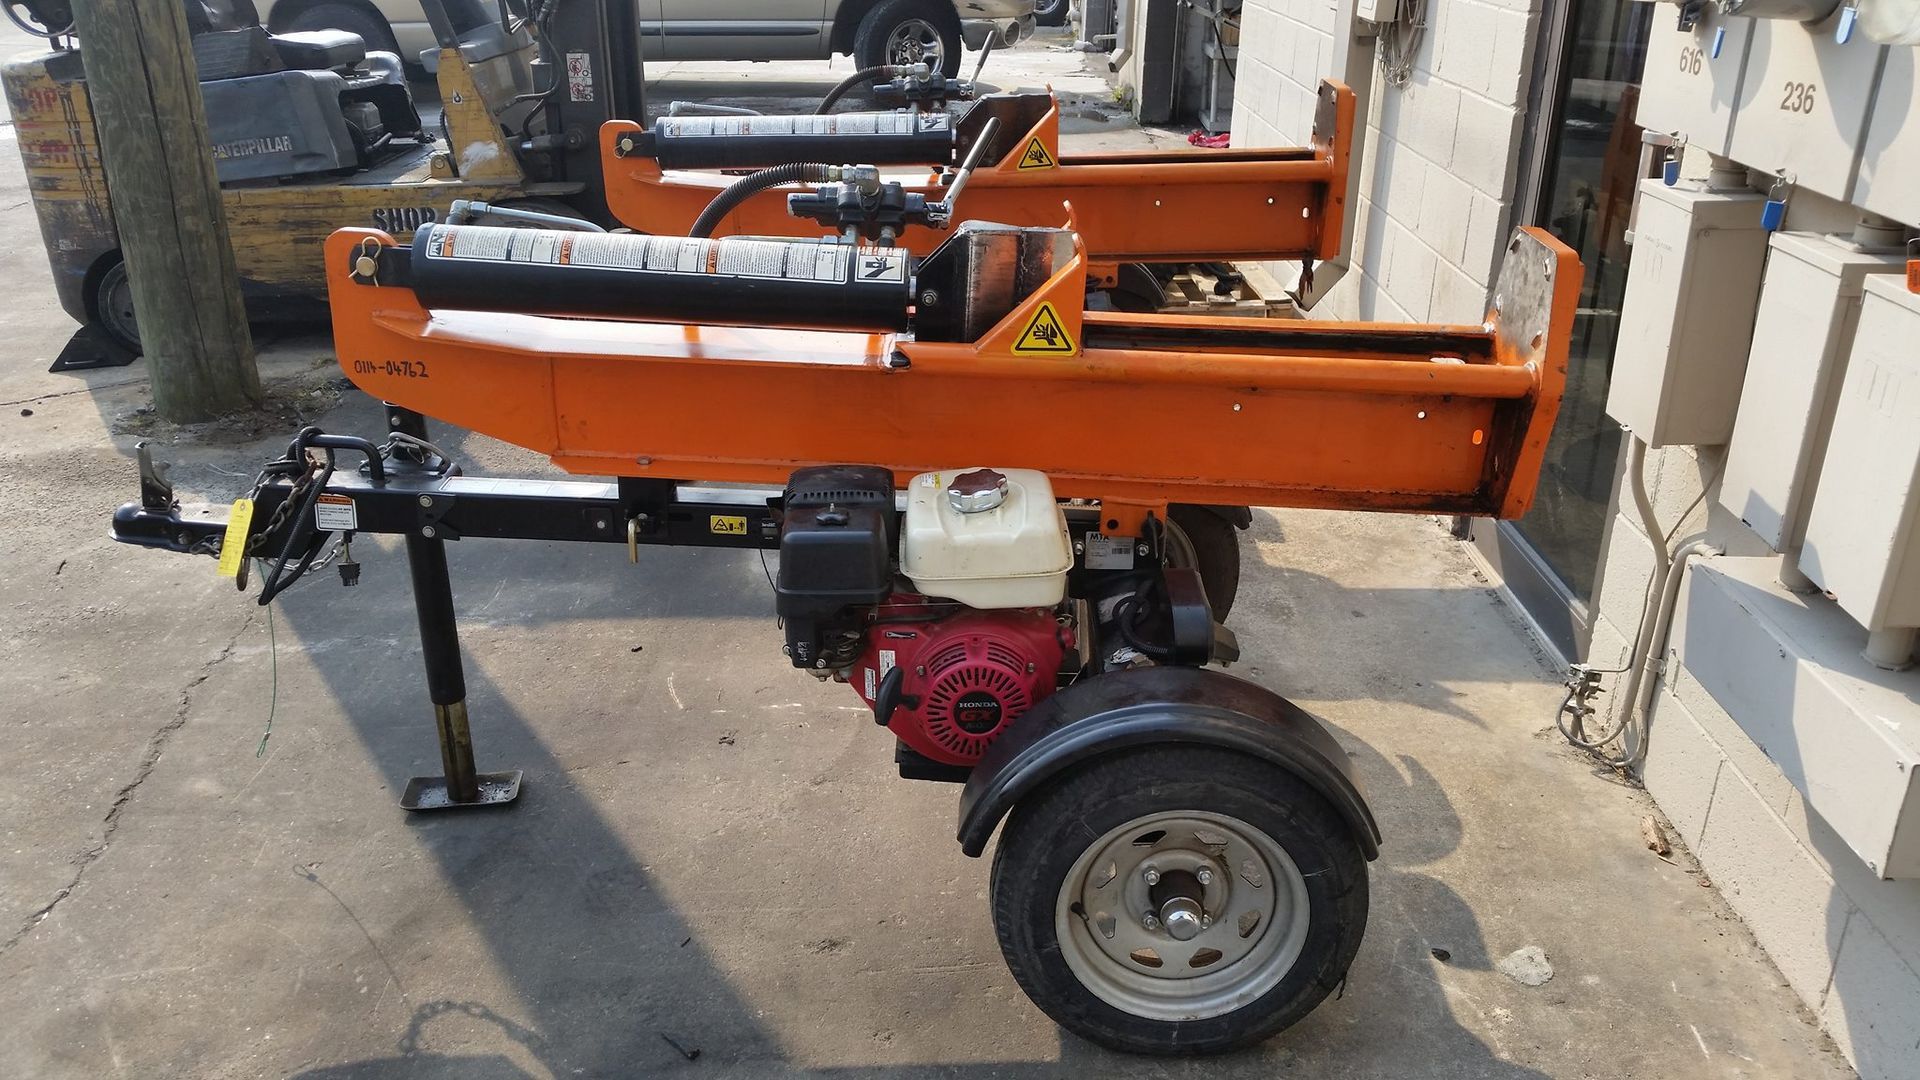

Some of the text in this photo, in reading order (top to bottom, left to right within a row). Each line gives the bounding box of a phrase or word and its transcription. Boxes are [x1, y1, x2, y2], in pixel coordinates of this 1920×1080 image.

[1679, 46, 1703, 76] 616
[1780, 81, 1816, 114] 236
[374, 207, 437, 232] SHOP
[354, 359, 429, 378] 0114-04762
